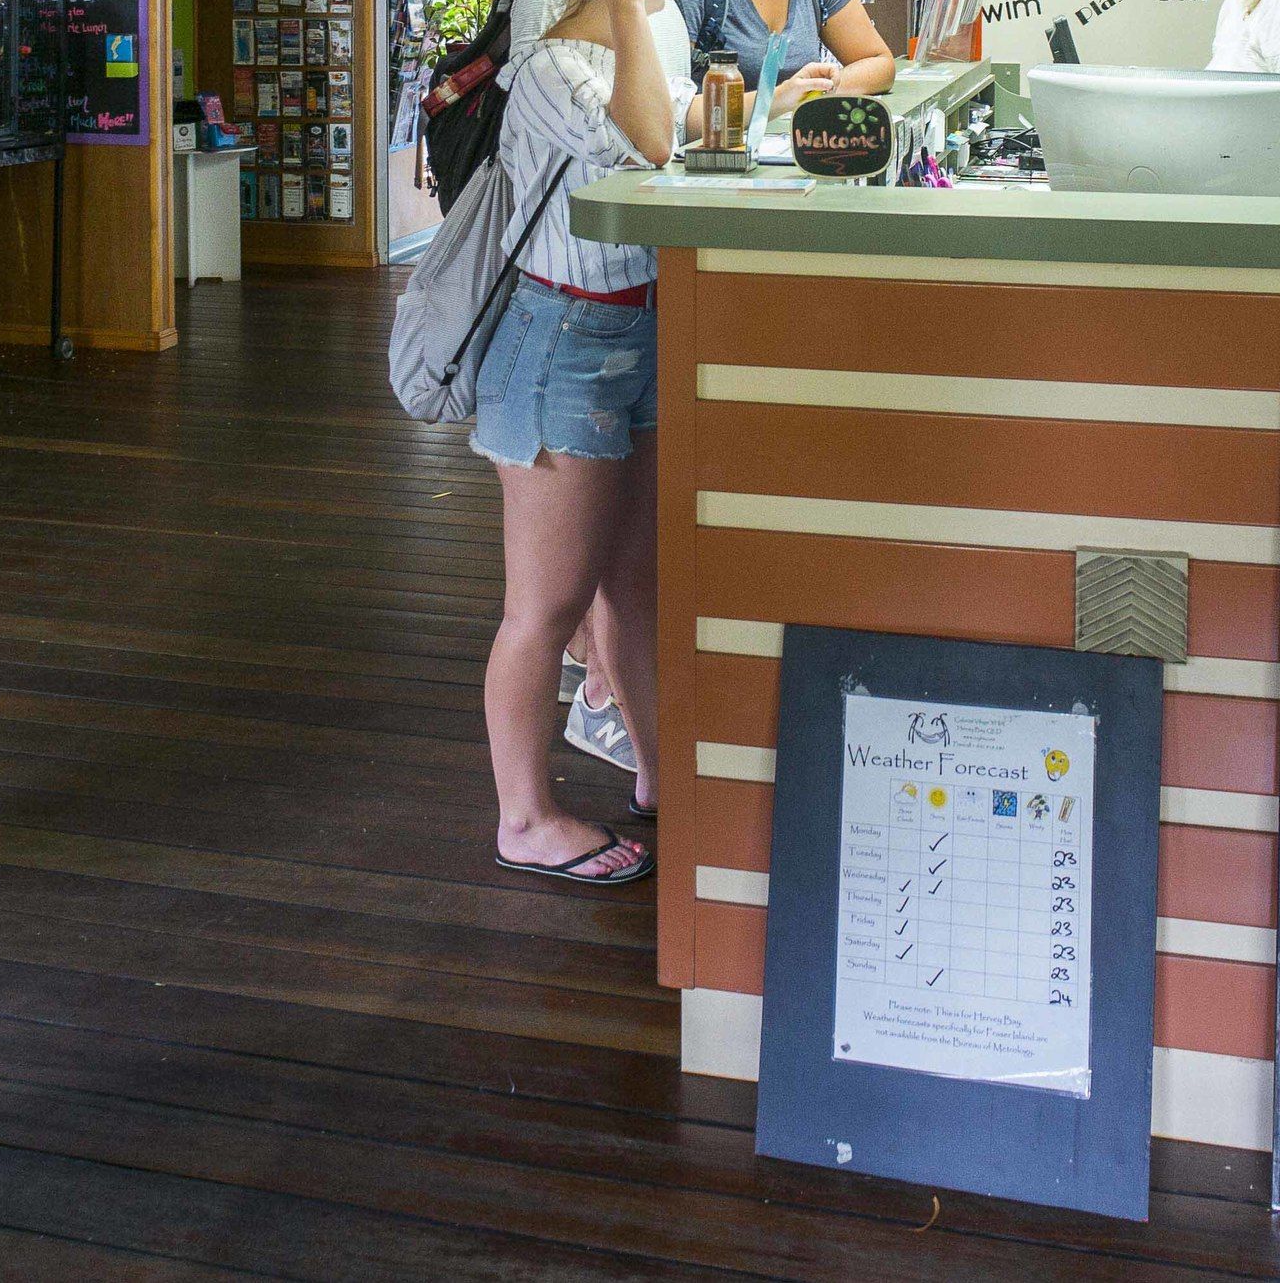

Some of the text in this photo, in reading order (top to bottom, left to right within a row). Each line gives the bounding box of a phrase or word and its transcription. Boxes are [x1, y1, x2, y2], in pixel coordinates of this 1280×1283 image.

[795, 126, 887, 149] Welcome!
[847, 743, 1029, 780] Weather Forecast
[850, 825, 882, 838] Monday
[848, 846, 882, 860] Tuesday
[1053, 850, 1077, 867] 23
[842, 869, 886, 884] Wednesday
[1051, 876, 1075, 891] 23
[847, 891, 882, 905] Thursday
[1052, 896, 1075, 913] 23
[851, 914, 875, 927] Friday
[1051, 921, 1073, 937] 23
[844, 936, 880, 950] Saturday
[1052, 944, 1075, 961] 23
[847, 959, 877, 972] Sunday
[1050, 967, 1070, 981] 23
[1049, 989, 1072, 1007] 24
[888, 999, 912, 1012] Please
[935, 1006, 952, 1017] This
[973, 1011, 1002, 1026] Hervey
[863, 1010, 896, 1024] Weather
[897, 1016, 930, 1029] forecasts
[986, 1027, 1012, 1039] Fraser
[1012, 1031, 1036, 1042] Island
[875, 1029, 889, 1037] not
[889, 1030, 920, 1041] available
[939, 1036, 951, 1046] the
[953, 1037, 982, 1050] Bureau
